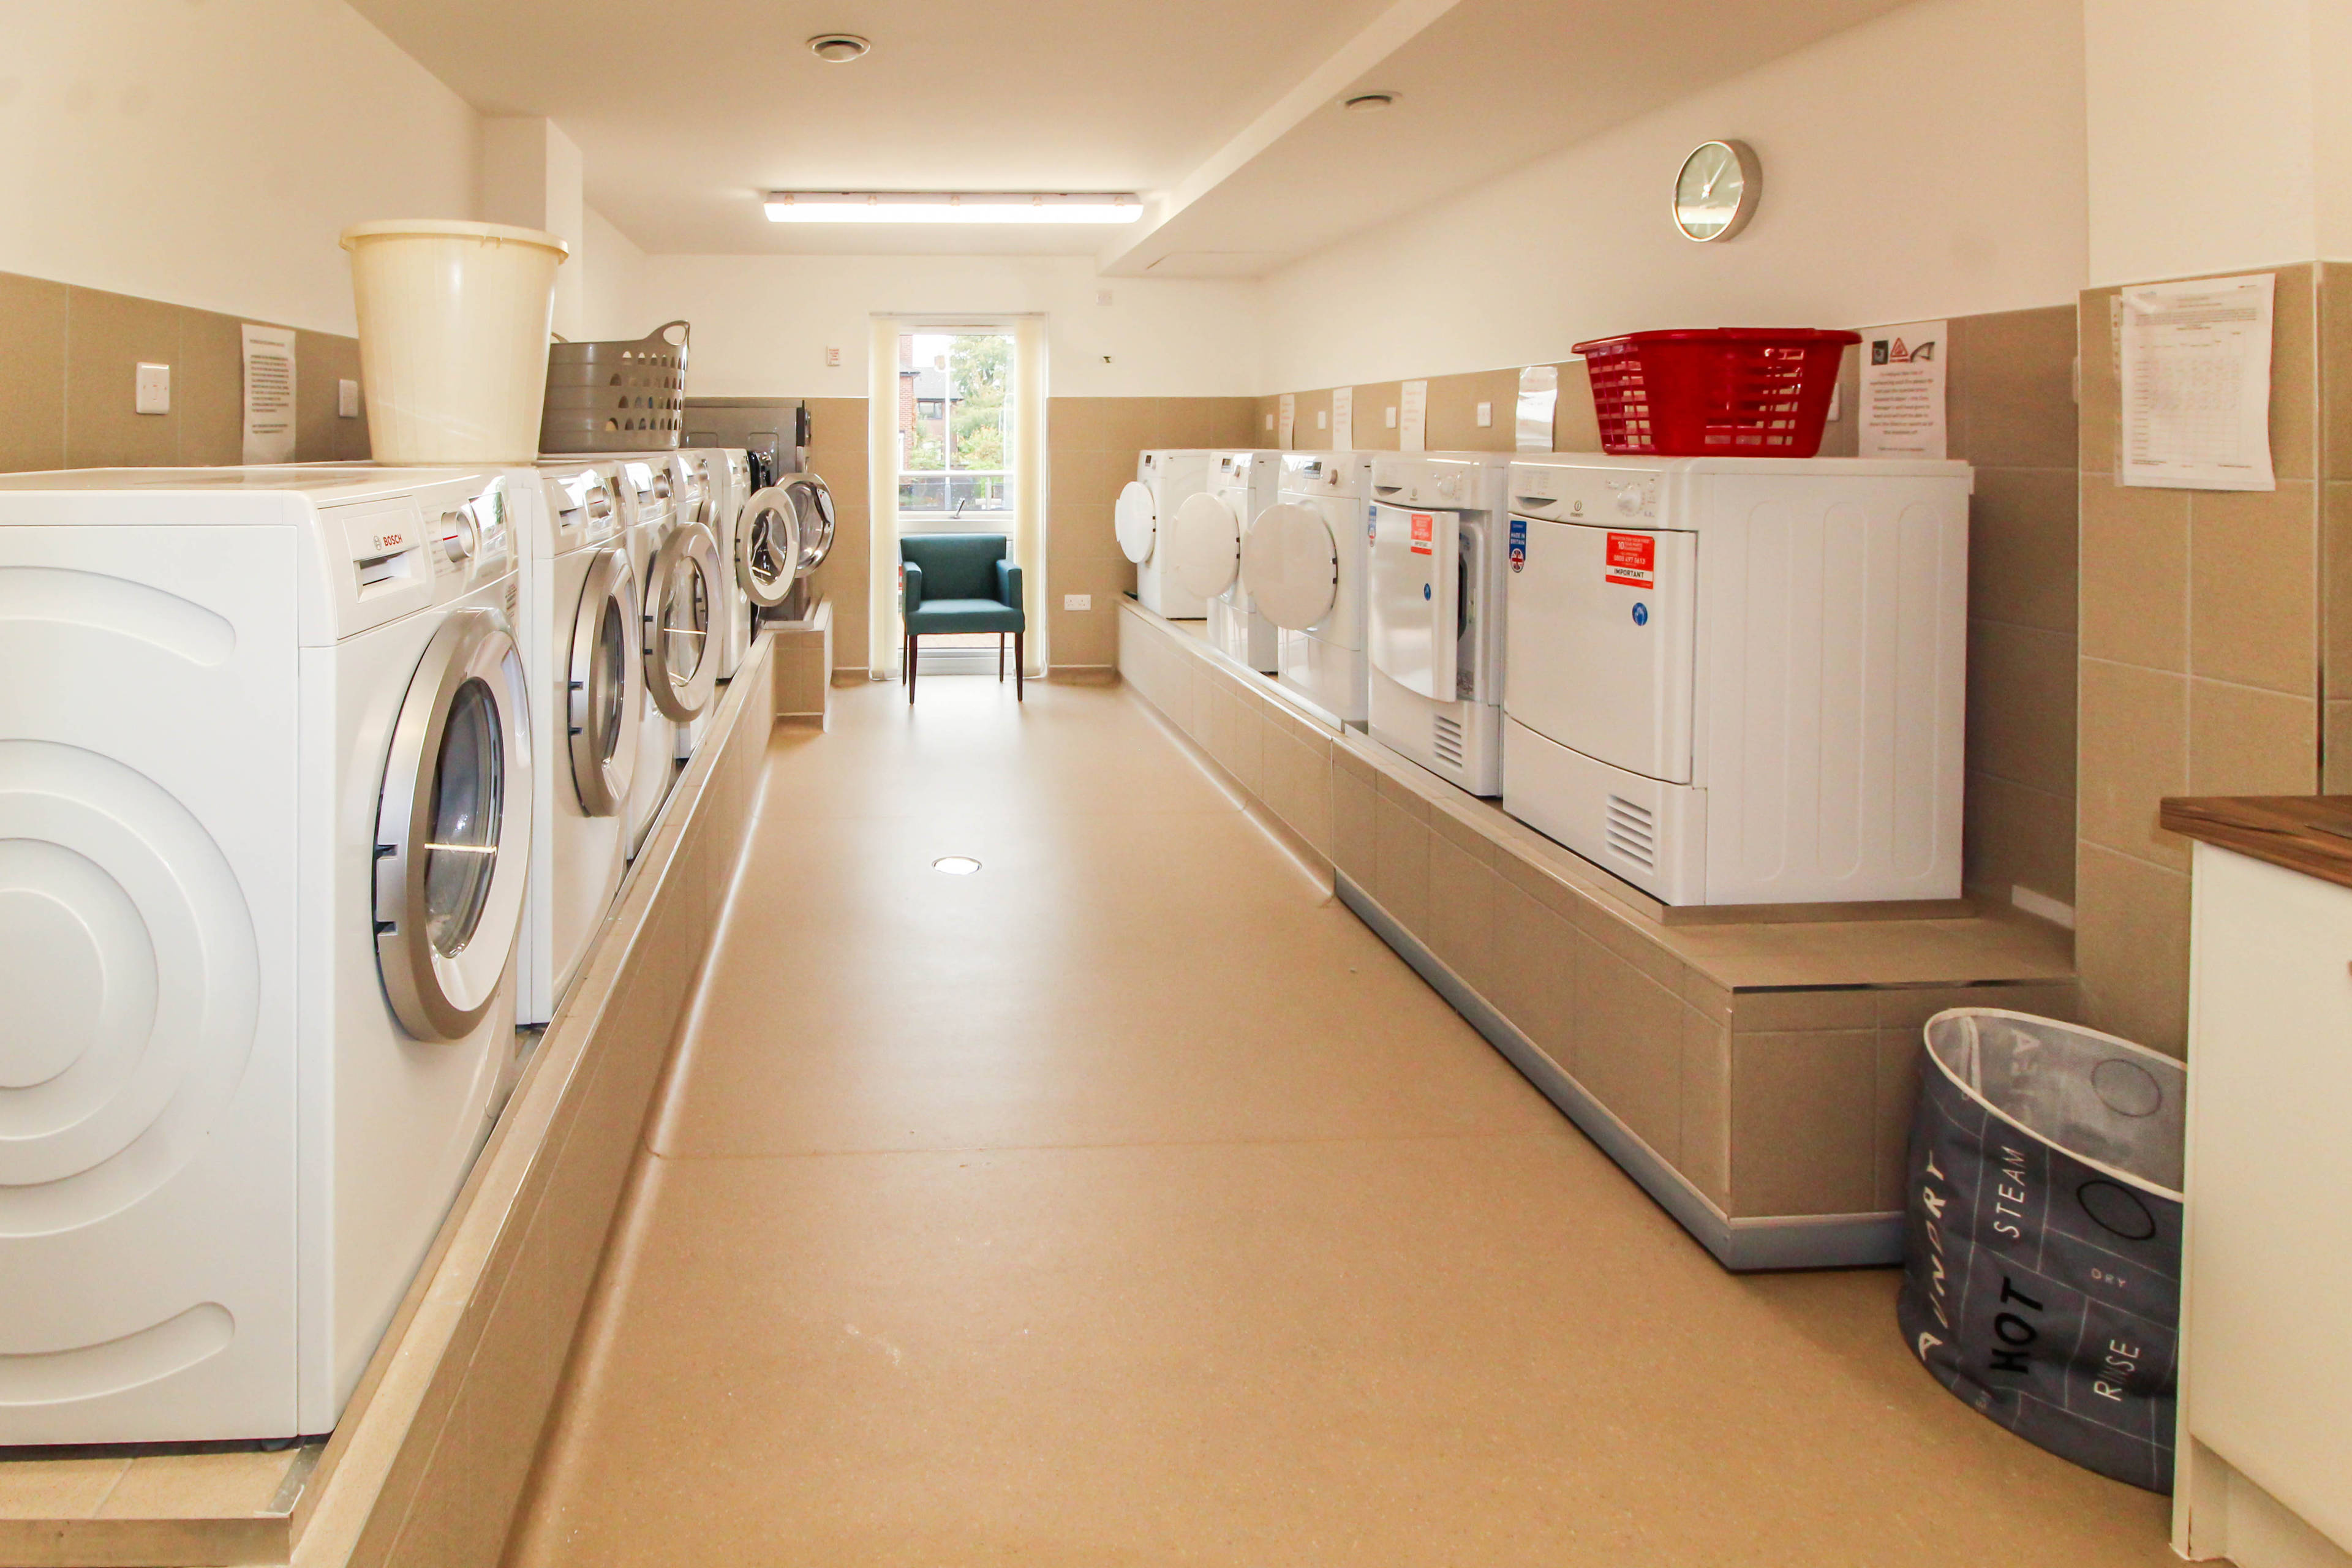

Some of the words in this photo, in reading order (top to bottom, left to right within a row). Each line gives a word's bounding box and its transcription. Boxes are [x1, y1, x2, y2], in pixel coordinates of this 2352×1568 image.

[383, 534, 402, 546] BOSCH
[1618, 541, 1625, 550] 10
[1614, 568, 1644, 578] IMPORTANT
[1993, 1145, 2026, 1238] STEAM
[2090, 1268, 2126, 1287] DRY
[1989, 1276, 2044, 1374] HOT
[2094, 1339, 2139, 1402] RINSE
